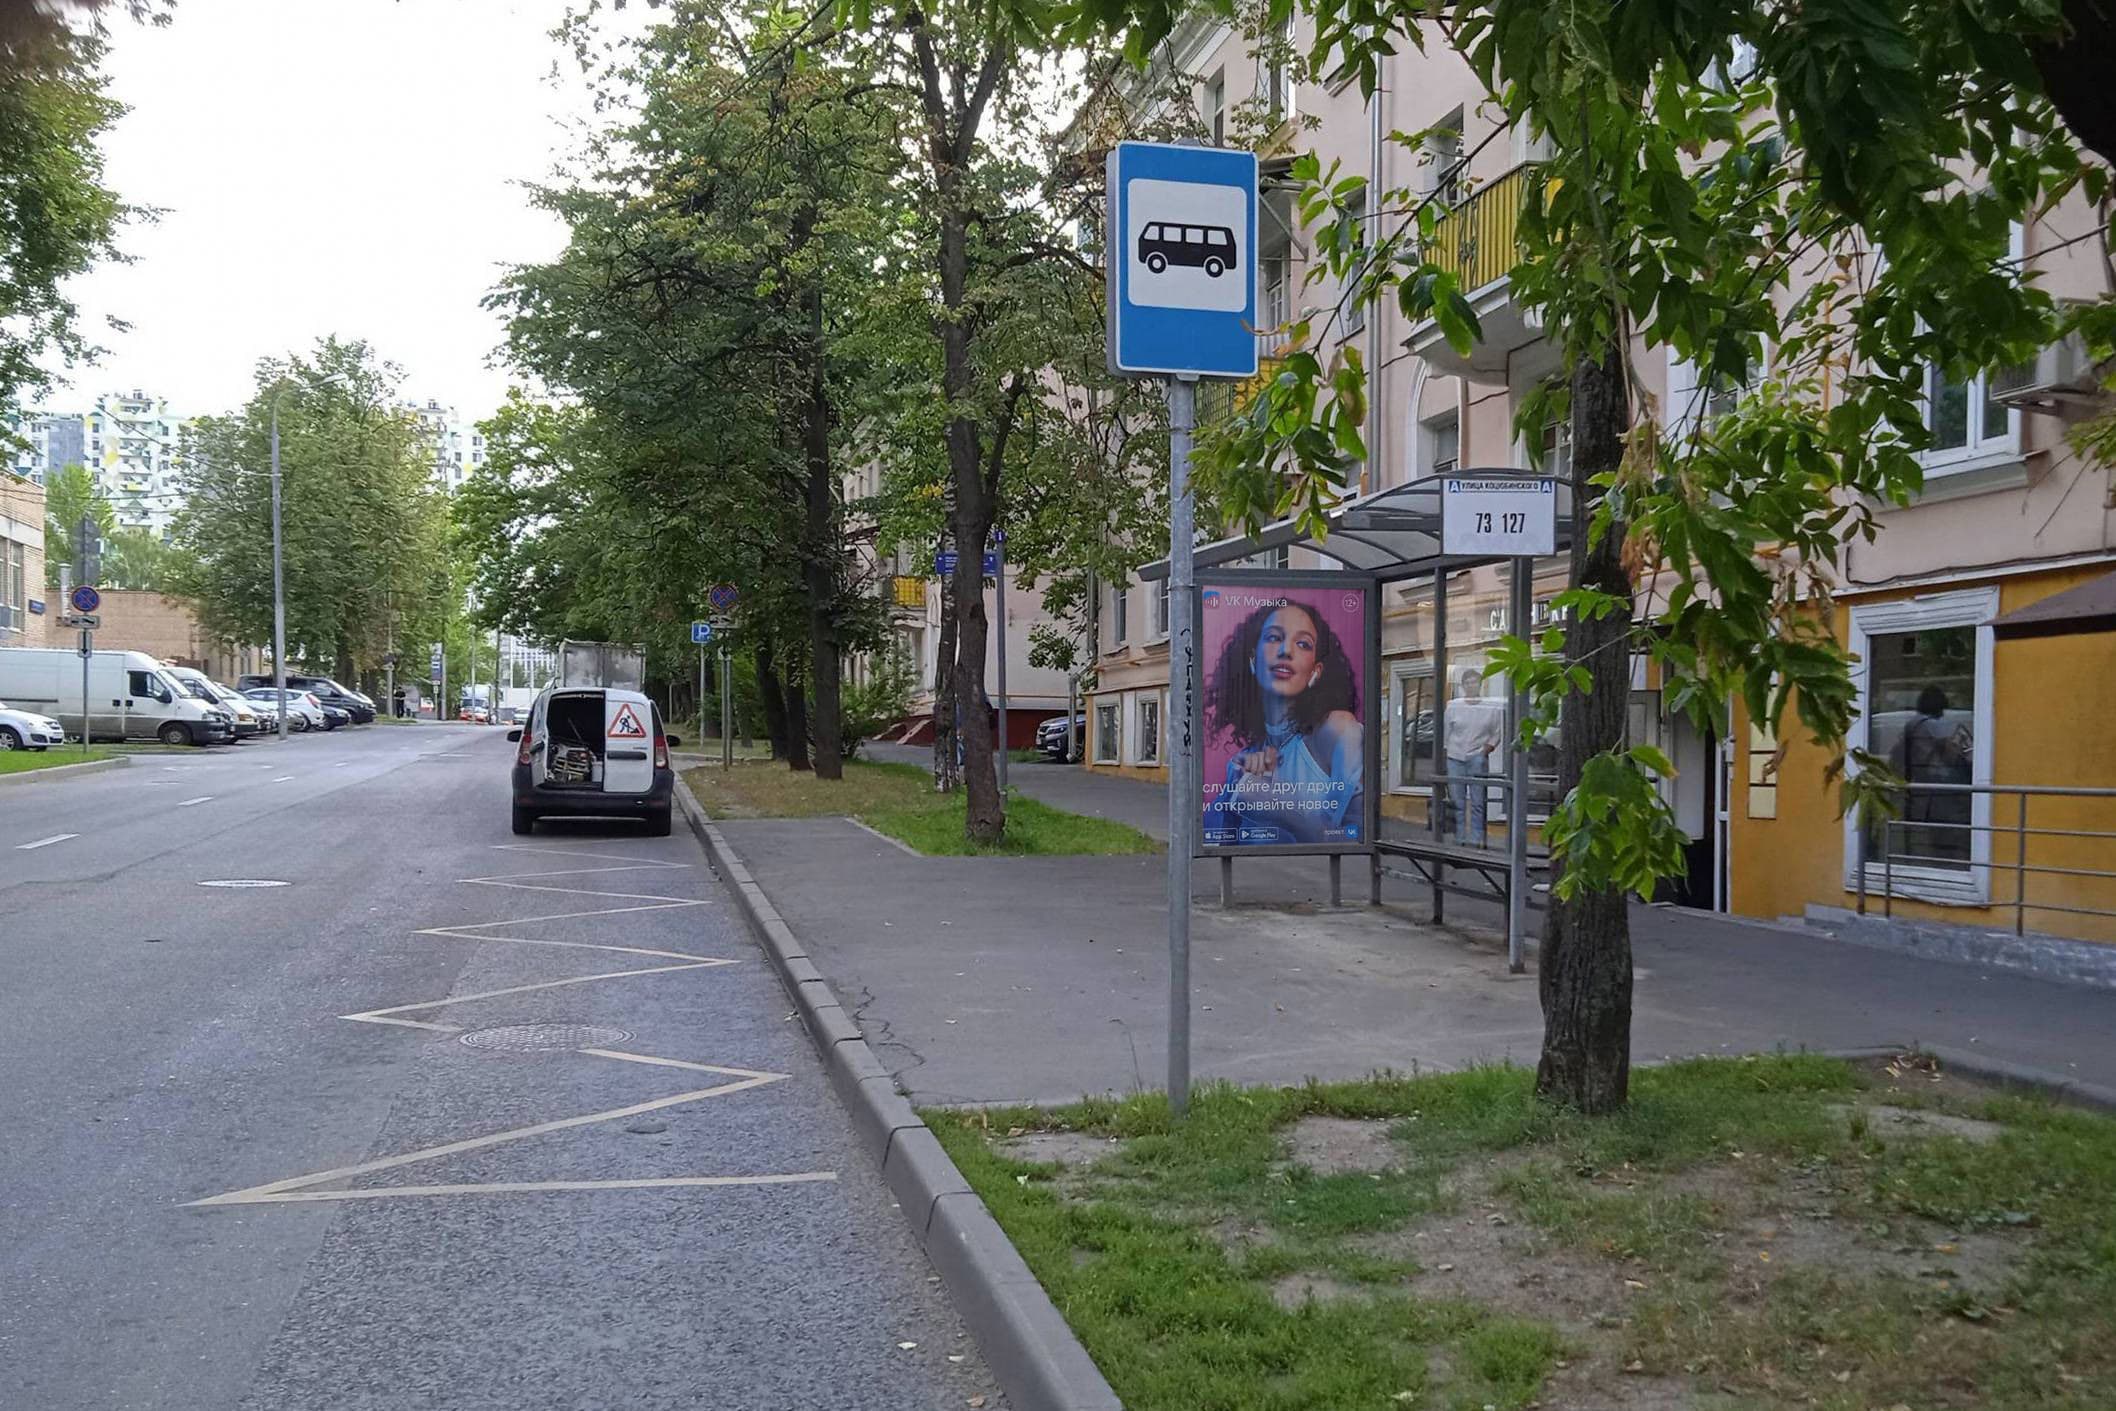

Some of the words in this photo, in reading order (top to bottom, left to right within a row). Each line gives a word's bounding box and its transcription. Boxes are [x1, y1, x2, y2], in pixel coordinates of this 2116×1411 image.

[1475, 512, 1492, 533] 73
[1502, 512, 1526, 533] 127
[1225, 596, 1241, 606] VK
[1244, 596, 1288, 608] Музыка
[1344, 599, 1357, 607] 12+
[1202, 779, 1270, 796] слушайте
[1272, 781, 1305, 795] друг
[1306, 780, 1345, 795] друга
[1202, 802, 1211, 812] и
[1214, 798, 1295, 814] открывайте
[1298, 800, 1339, 810] новое
